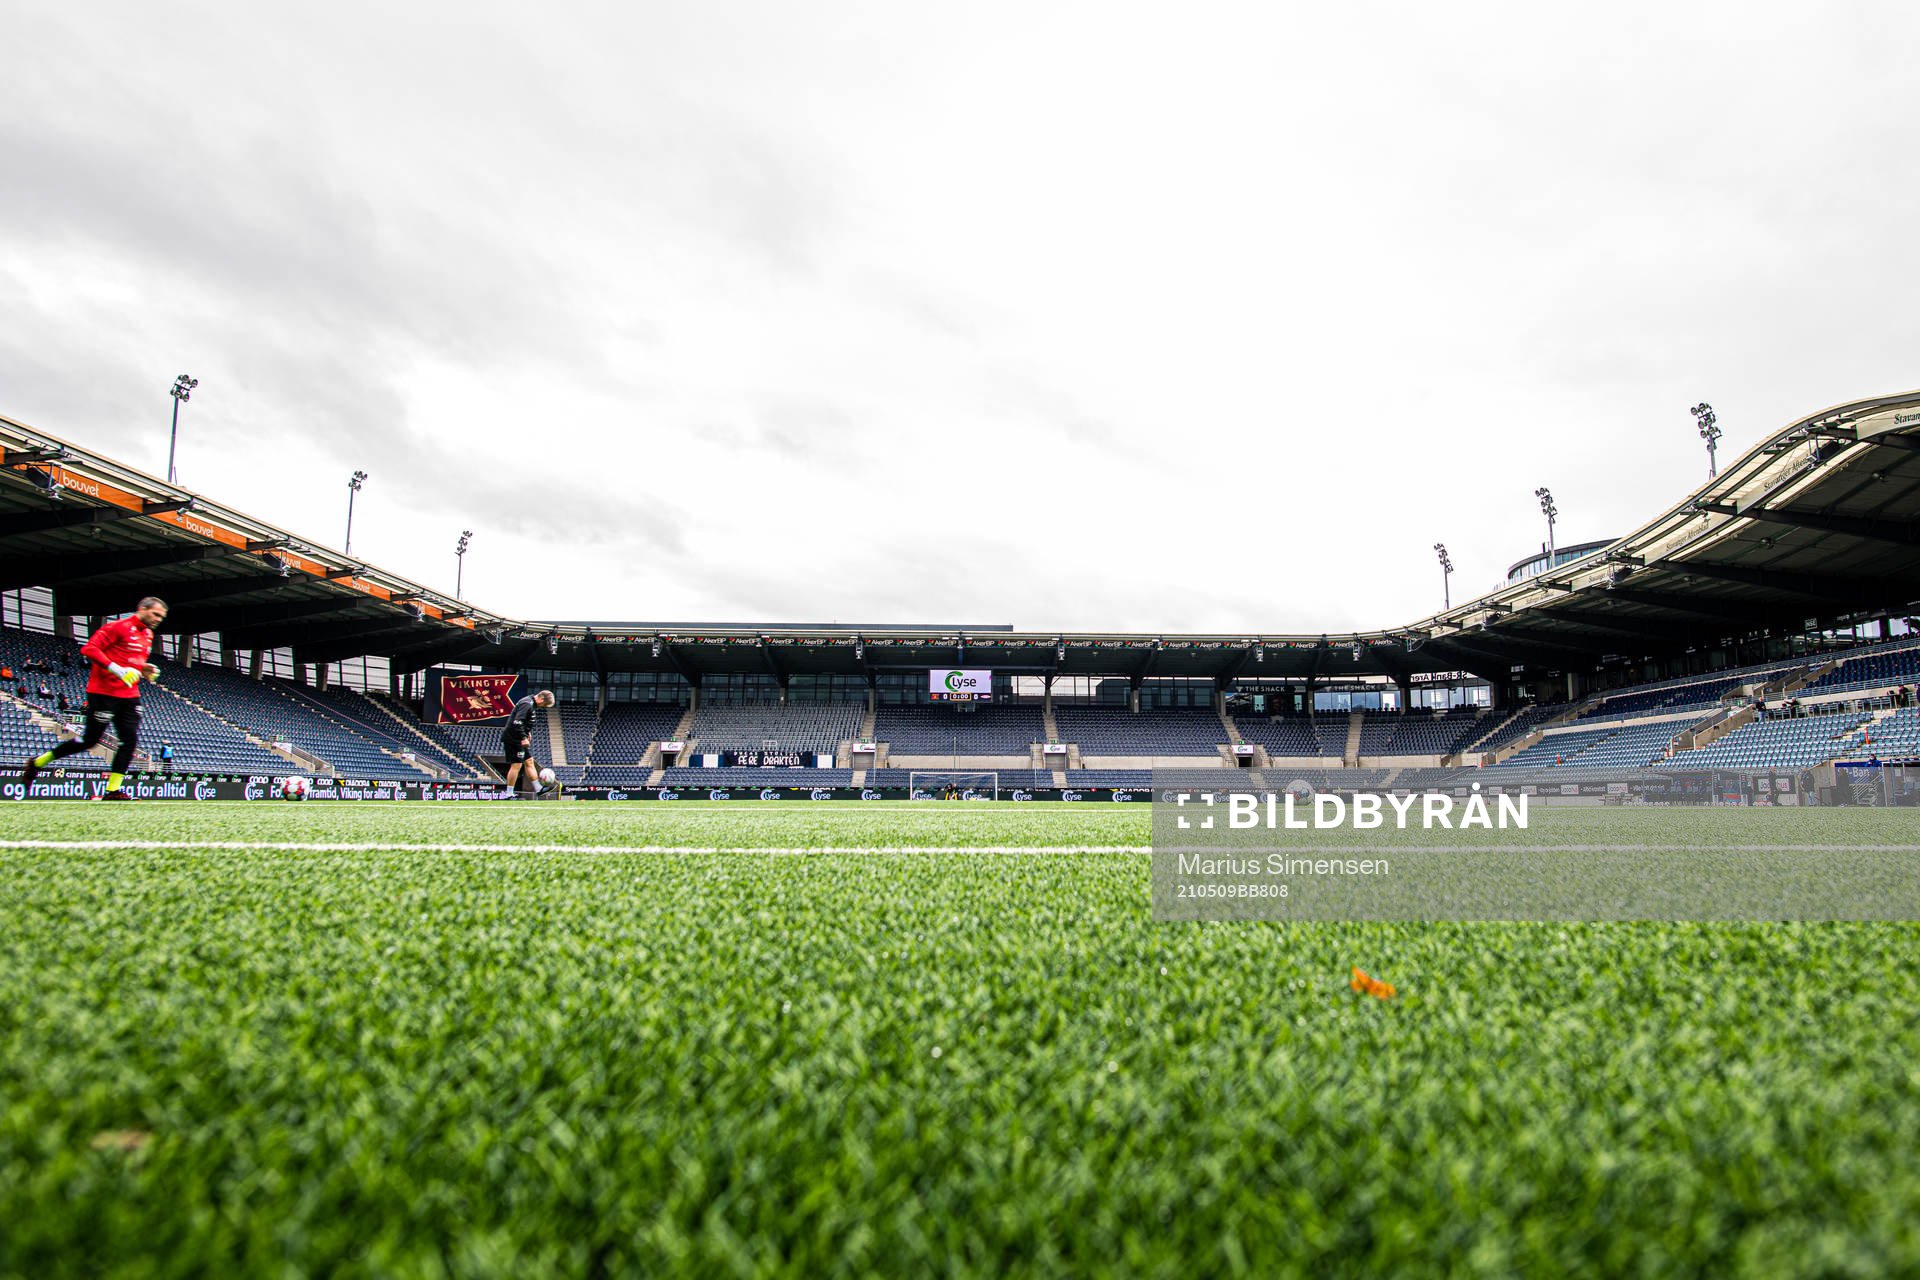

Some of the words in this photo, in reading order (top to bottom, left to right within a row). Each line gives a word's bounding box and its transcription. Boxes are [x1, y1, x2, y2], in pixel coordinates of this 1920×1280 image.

[62, 471, 100, 498] bouvet
[186, 516, 215, 538] bouvet
[450, 679, 490, 689] VIKING
[952, 676, 977, 690] Lyse
[453, 708, 504, 719] STAVANGER
[764, 756, 800, 765] DRAKTEN
[4, 783, 25, 800] og
[30, 780, 90, 800] framtid,
[137, 781, 154, 797] for
[156, 780, 187, 797] alltid
[198, 784, 216, 799] Lyse
[248, 785, 264, 800] Lyse
[310, 786, 339, 800] framtid,
[340, 787, 362, 800] Viking
[364, 787, 373, 798] for
[374, 787, 390, 798] alltid
[612, 791, 628, 800] Lyse
[663, 791, 678, 800] Lyse
[714, 791, 730, 800] Lyse
[764, 791, 780, 800] Lyse
[816, 791, 831, 800] Lyse
[866, 792, 882, 800] Lyse
[1016, 792, 1032, 801] Lyse
[1066, 792, 1082, 802] Lyse
[1116, 792, 1132, 802] Lyse
